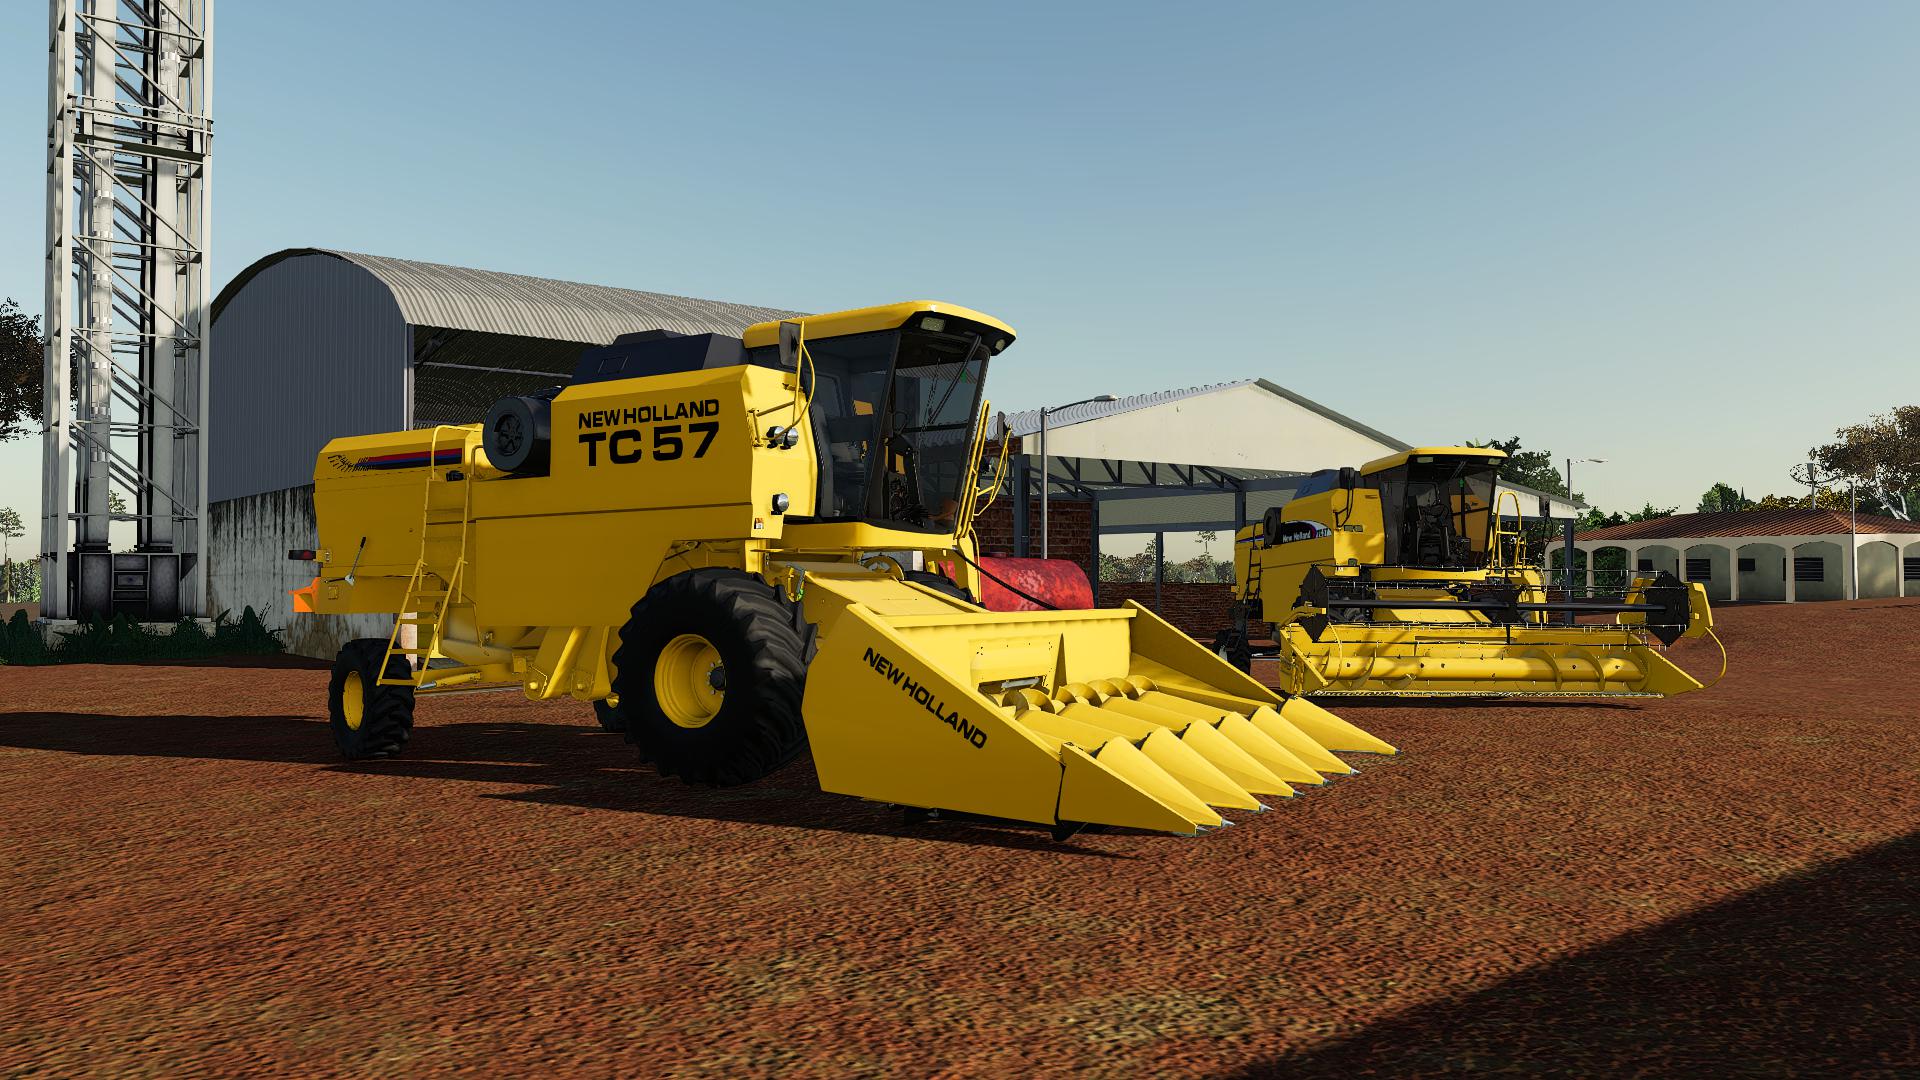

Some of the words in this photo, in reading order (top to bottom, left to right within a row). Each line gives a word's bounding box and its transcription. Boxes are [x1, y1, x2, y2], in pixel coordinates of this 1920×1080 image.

[579, 409, 620, 429] NEW
[623, 399, 719, 424] HOLLAND
[863, 647, 905, 685] NEW
[902, 676, 987, 749] HOLLAND
